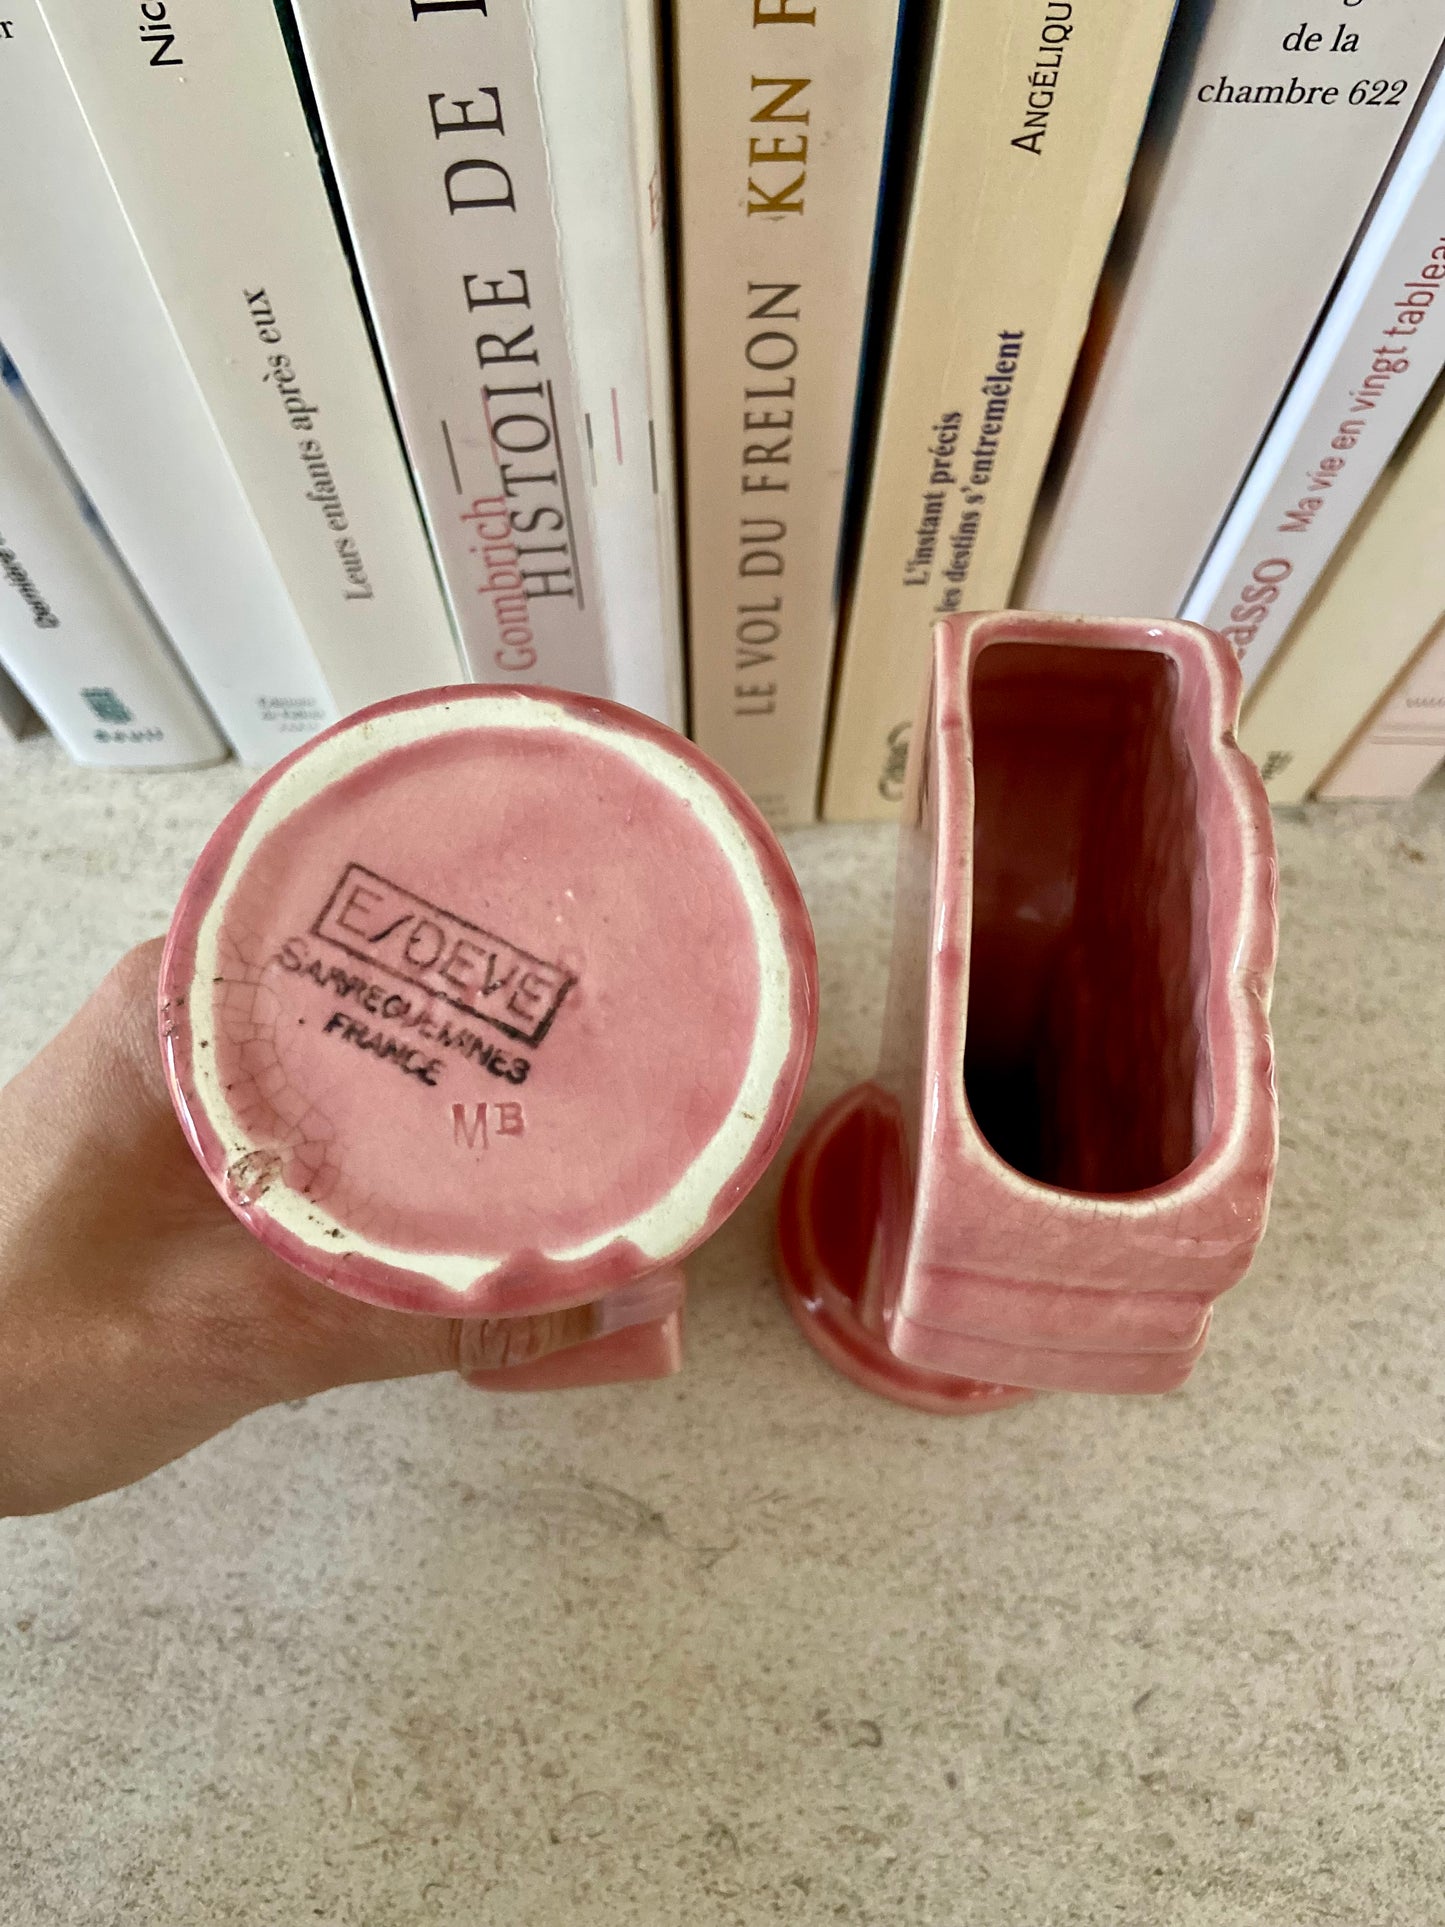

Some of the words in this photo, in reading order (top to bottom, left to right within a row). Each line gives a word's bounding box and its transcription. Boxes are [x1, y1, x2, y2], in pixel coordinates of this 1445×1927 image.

[1282, 23, 1323, 52] de
[1329, 24, 1360, 52] la
[1197, 75, 1339, 105] chambre
[1348, 79, 1408, 106] 622
[428, 87, 517, 216] DE
[746, 74, 812, 217] KEN
[243, 288, 282, 344] eux
[262, 353, 319, 430] après
[741, 280, 802, 496] FRELON
[1277, 496, 1324, 532] Ma
[1305, 456, 1346, 492] vie
[1330, 419, 1367, 450] en
[1349, 345, 1410, 412] vingt
[1382, 236, 1445, 337] tablea
[463, 269, 576, 600] HISTOIRE
[926, 410, 963, 485] précis
[298, 439, 349, 531] enfants
[334, 536, 375, 600] Leurs
[460, 494, 538, 673] Gombrich
[738, 517, 788, 578] DU
[941, 510, 981, 583] destins
[735, 595, 783, 678] VOL
[734, 681, 778, 717] LE
